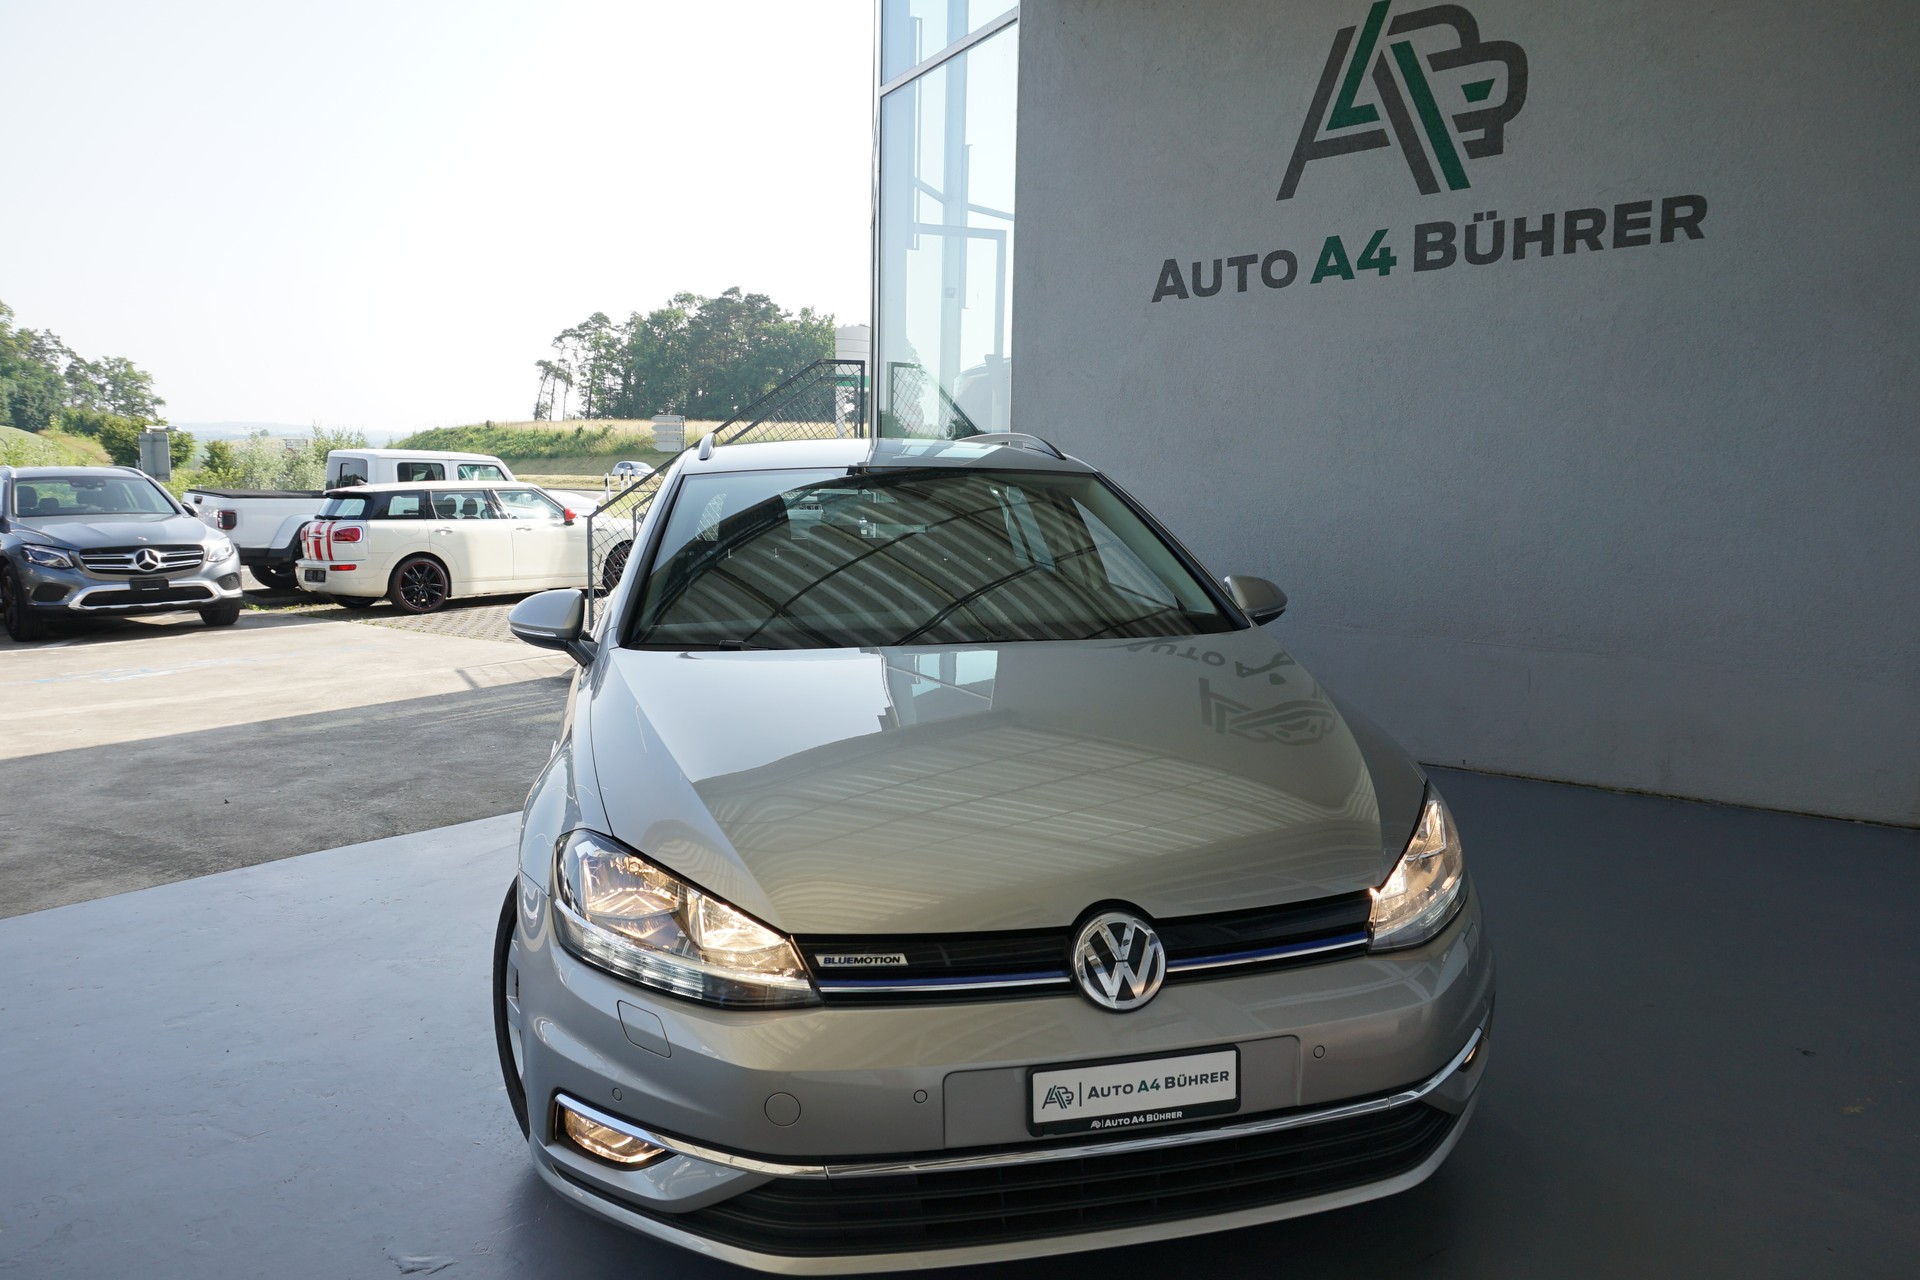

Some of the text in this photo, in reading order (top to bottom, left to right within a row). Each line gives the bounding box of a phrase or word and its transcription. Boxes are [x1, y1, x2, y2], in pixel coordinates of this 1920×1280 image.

[1151, 193, 1708, 303] AUTO A4 BÜHRER
[823, 956, 900, 965] BLUEMOTION
[1087, 1083, 1134, 1099] AUTO
[1137, 1078, 1160, 1093] A4
[1164, 1071, 1229, 1089] BÜHRER
[1104, 1117, 1130, 1128] AUTO
[1131, 1115, 1145, 1124] A4
[1146, 1111, 1183, 1122] BÜHRER
